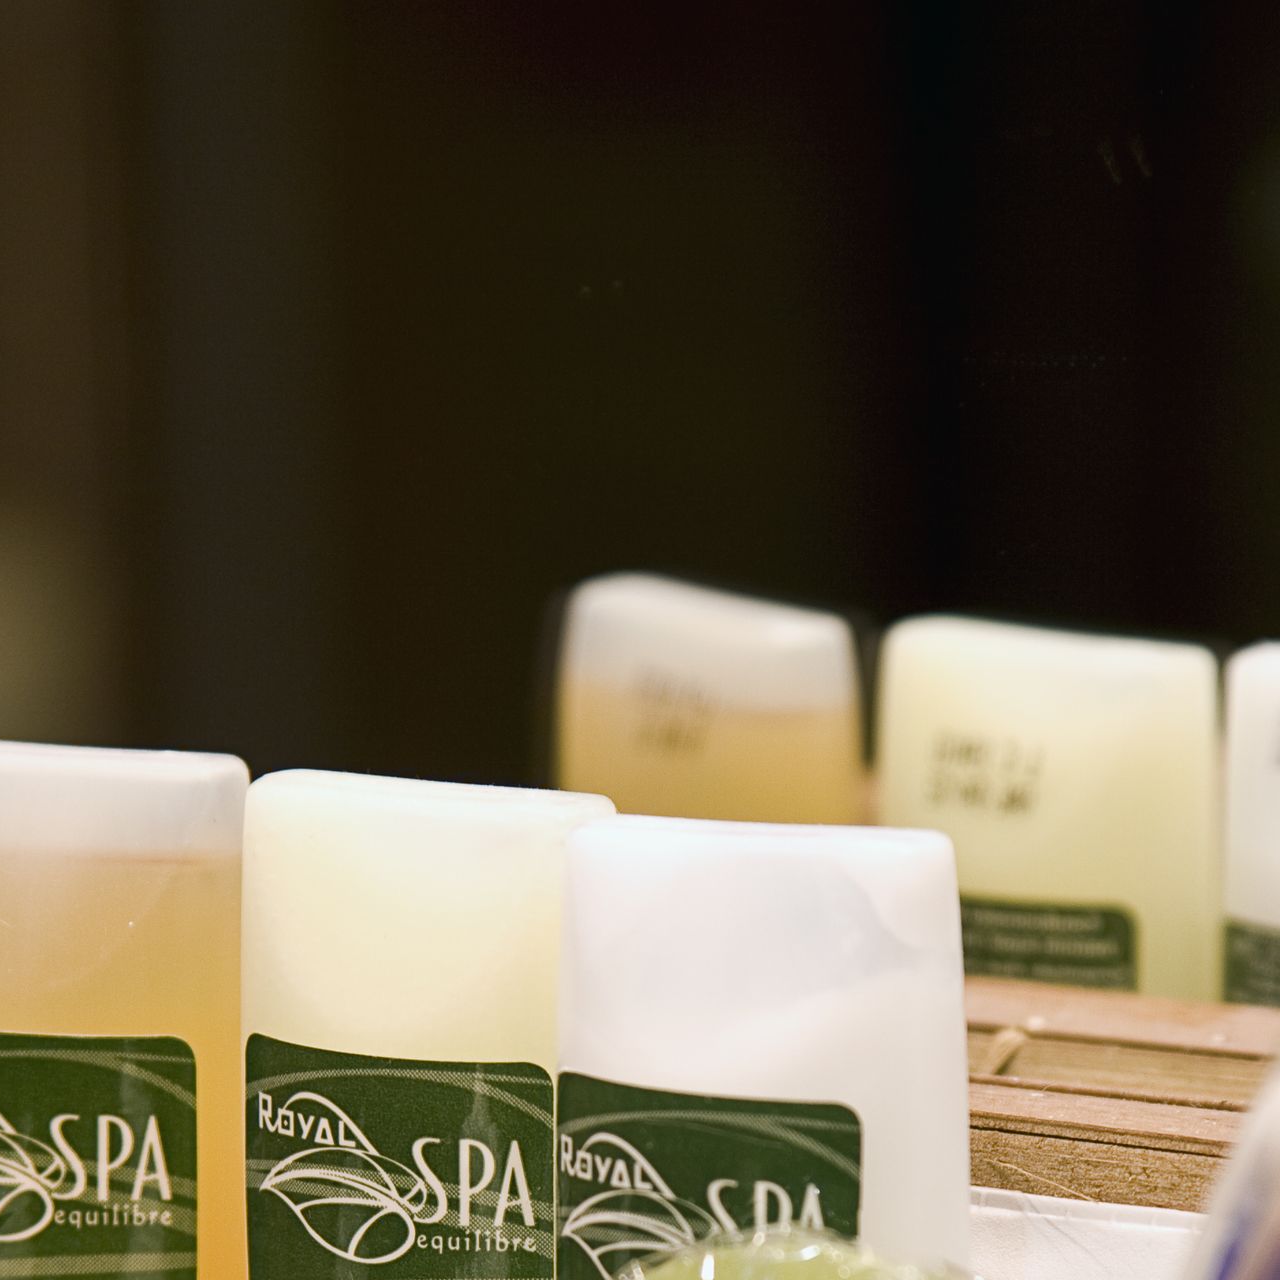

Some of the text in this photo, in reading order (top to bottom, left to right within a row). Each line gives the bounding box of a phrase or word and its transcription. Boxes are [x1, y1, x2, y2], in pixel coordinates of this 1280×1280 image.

[49, 1113, 173, 1201] SPA
[411, 1136, 536, 1227] SPA
[53, 1203, 173, 1229] equilibre
[416, 1229, 537, 1254] equilibre
[706, 1178, 825, 1242] SPA
